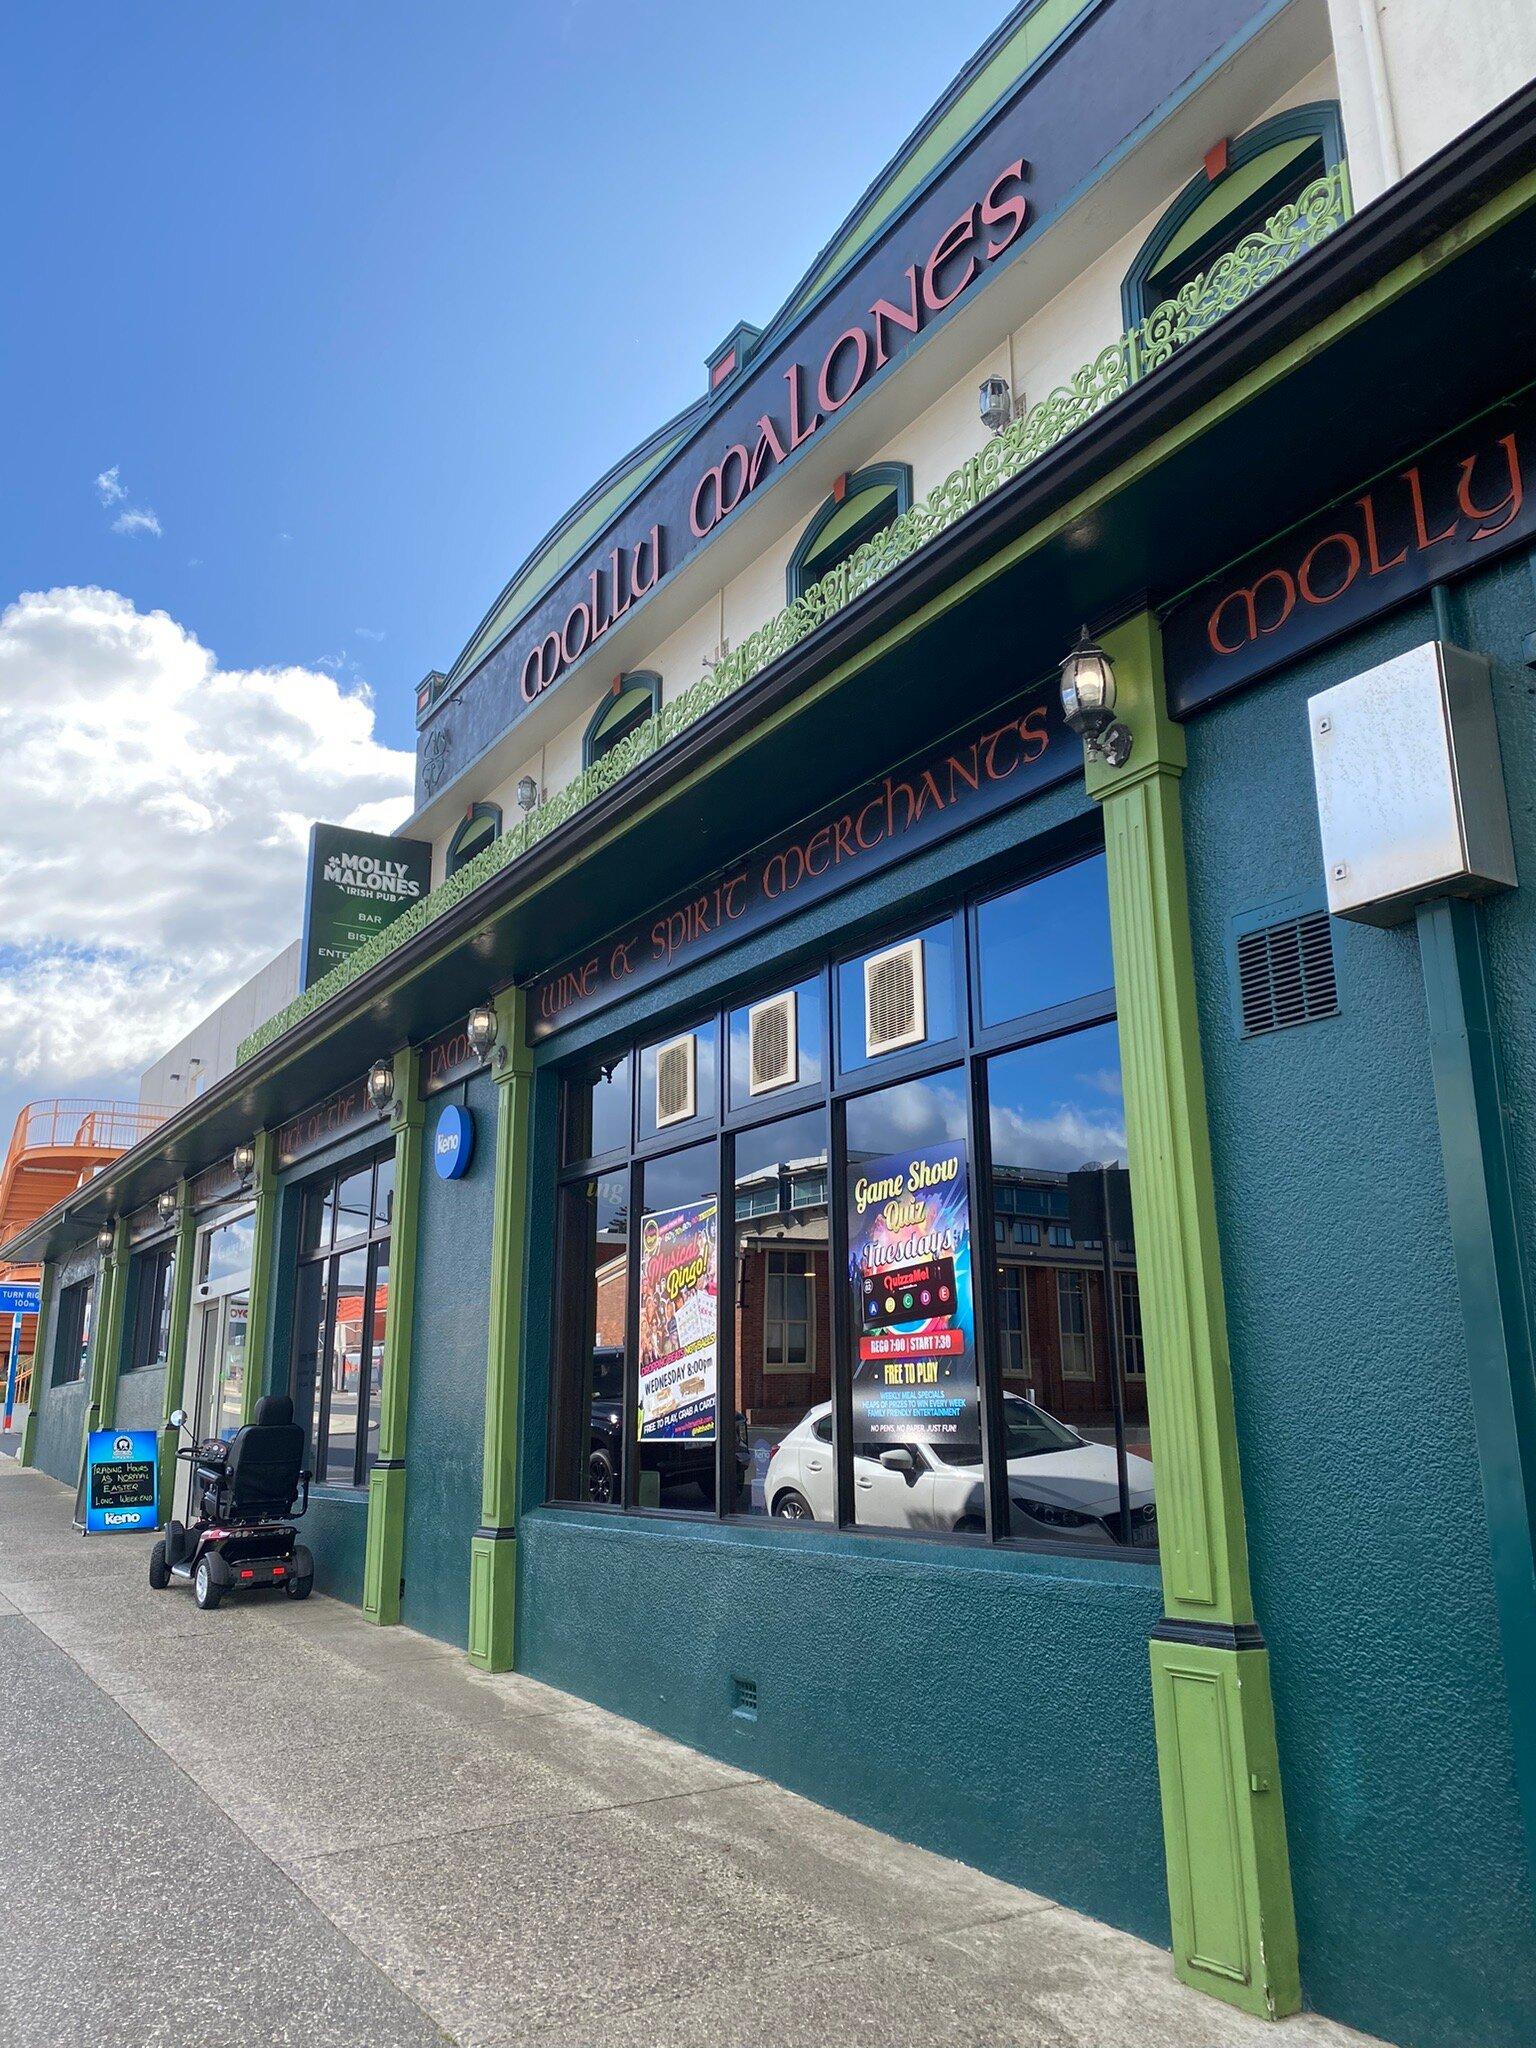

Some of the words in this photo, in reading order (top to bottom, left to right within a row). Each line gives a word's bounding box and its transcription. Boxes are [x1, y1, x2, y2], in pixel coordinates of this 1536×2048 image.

[689, 158, 1030, 539] MALONES
[1207, 433, 1524, 654] MOLLY
[341, 852, 410, 879] MOLLY
[541, 957, 600, 1018] WINE
[650, 873, 747, 967] SPIRIT
[762, 705, 1050, 900] MERCHANTS
[323, 864, 420, 897] MALONES
[346, 886, 374, 899] IRISH
[376, 891, 397, 903] PUB
[358, 913, 382, 924] BAR
[347, 932, 374, 942] BIST
[437, 1133, 459, 1155] Keno
[855, 1174, 903, 1214] Game
[907, 1157, 958, 1192] Show
[884, 1196, 926, 1233] Quiz
[648, 1232, 699, 1286] Musical
[863, 1228, 952, 1268] Tuesdays
[667, 1245, 709, 1300] Bingo!
[3, 1291, 24, 1299] TURN
[27, 1291, 40, 1299] RIG
[870, 1339, 889, 1353] REGO
[890, 1338, 905, 1352] 7:00
[910, 1336, 933, 1351] START
[934, 1335, 951, 1349] 7:30
[645, 1364, 686, 1395] WEDNESDAY
[884, 1363, 903, 1384] FREE
[904, 1363, 915, 1383] TO
[917, 1362, 938, 1383] PLAY
[917, 1390, 945, 1399] SPECIALS
[930, 1399, 948, 1407] EVERY
[644, 1422, 656, 1434] FREE
[657, 1419, 664, 1429] TO
[693, 1404, 698, 1412] A
[913, 1408, 960, 1416] ENTERTAINMENT
[101, 1475, 112, 1483] AS
[103, 1483, 139, 1493] EASTER
